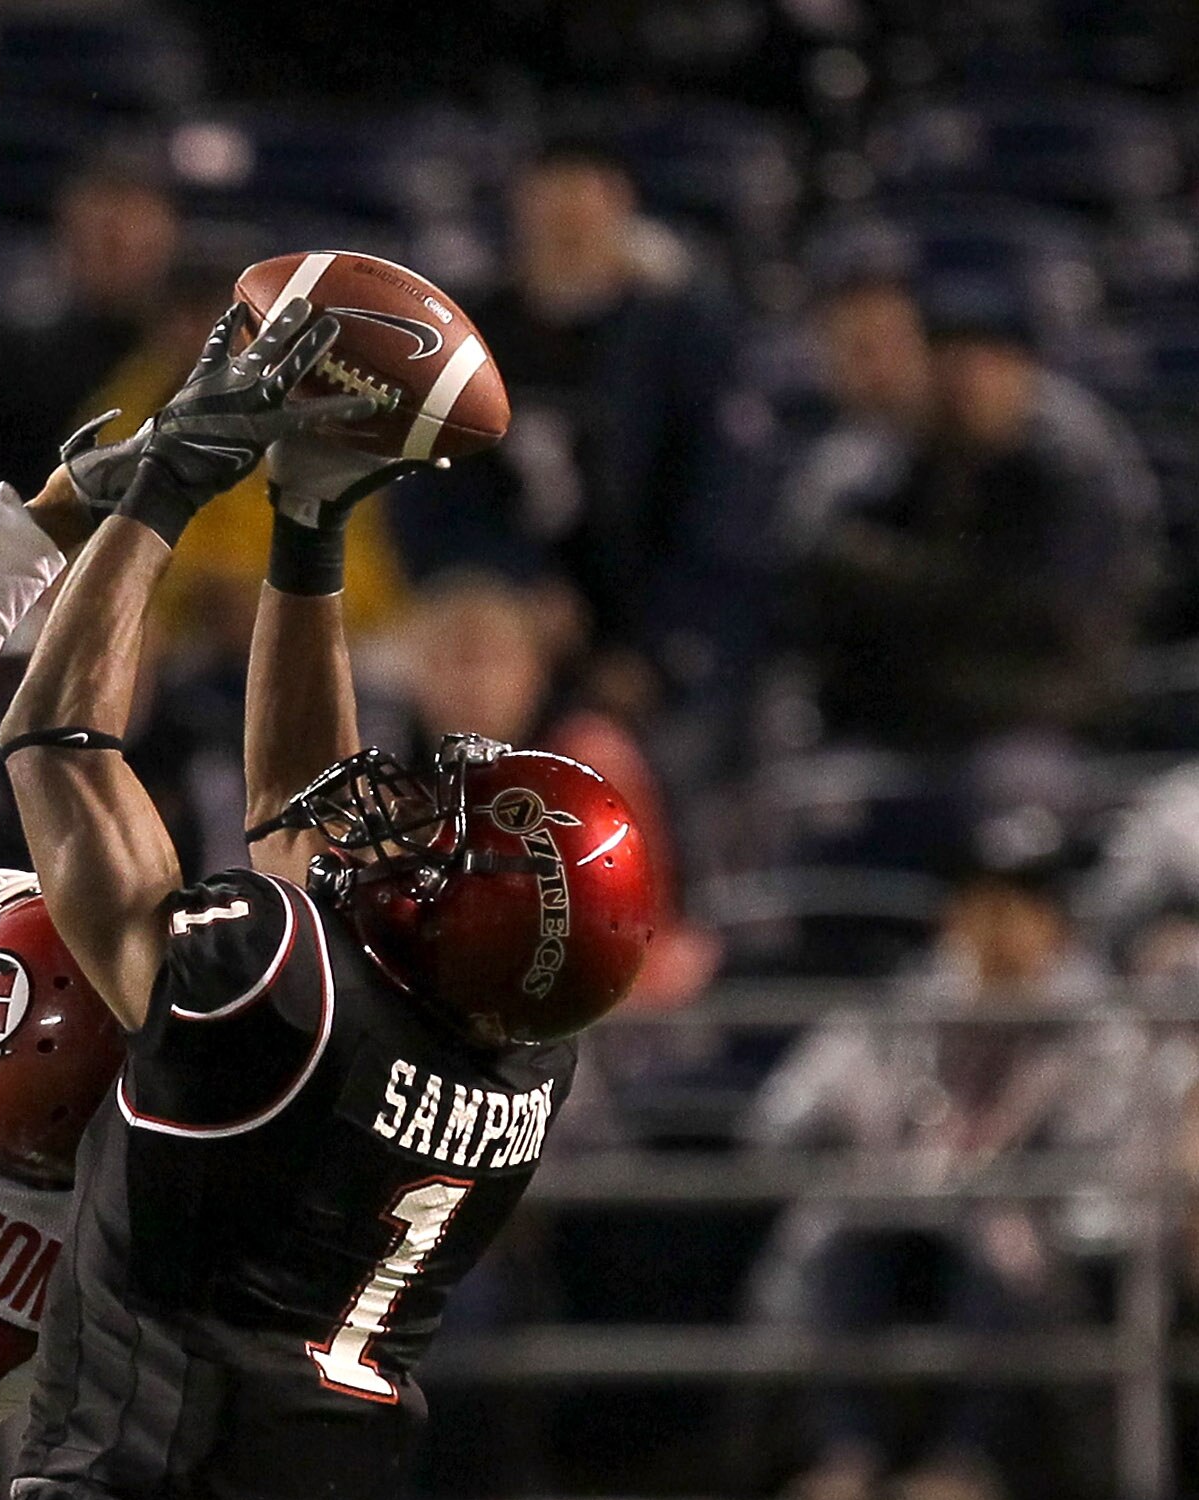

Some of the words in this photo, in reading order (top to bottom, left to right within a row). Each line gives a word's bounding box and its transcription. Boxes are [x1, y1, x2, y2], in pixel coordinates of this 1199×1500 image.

[170, 898, 251, 936] 1
[373, 1059, 554, 1168] SAMPSON
[304, 1175, 476, 1404] 1
